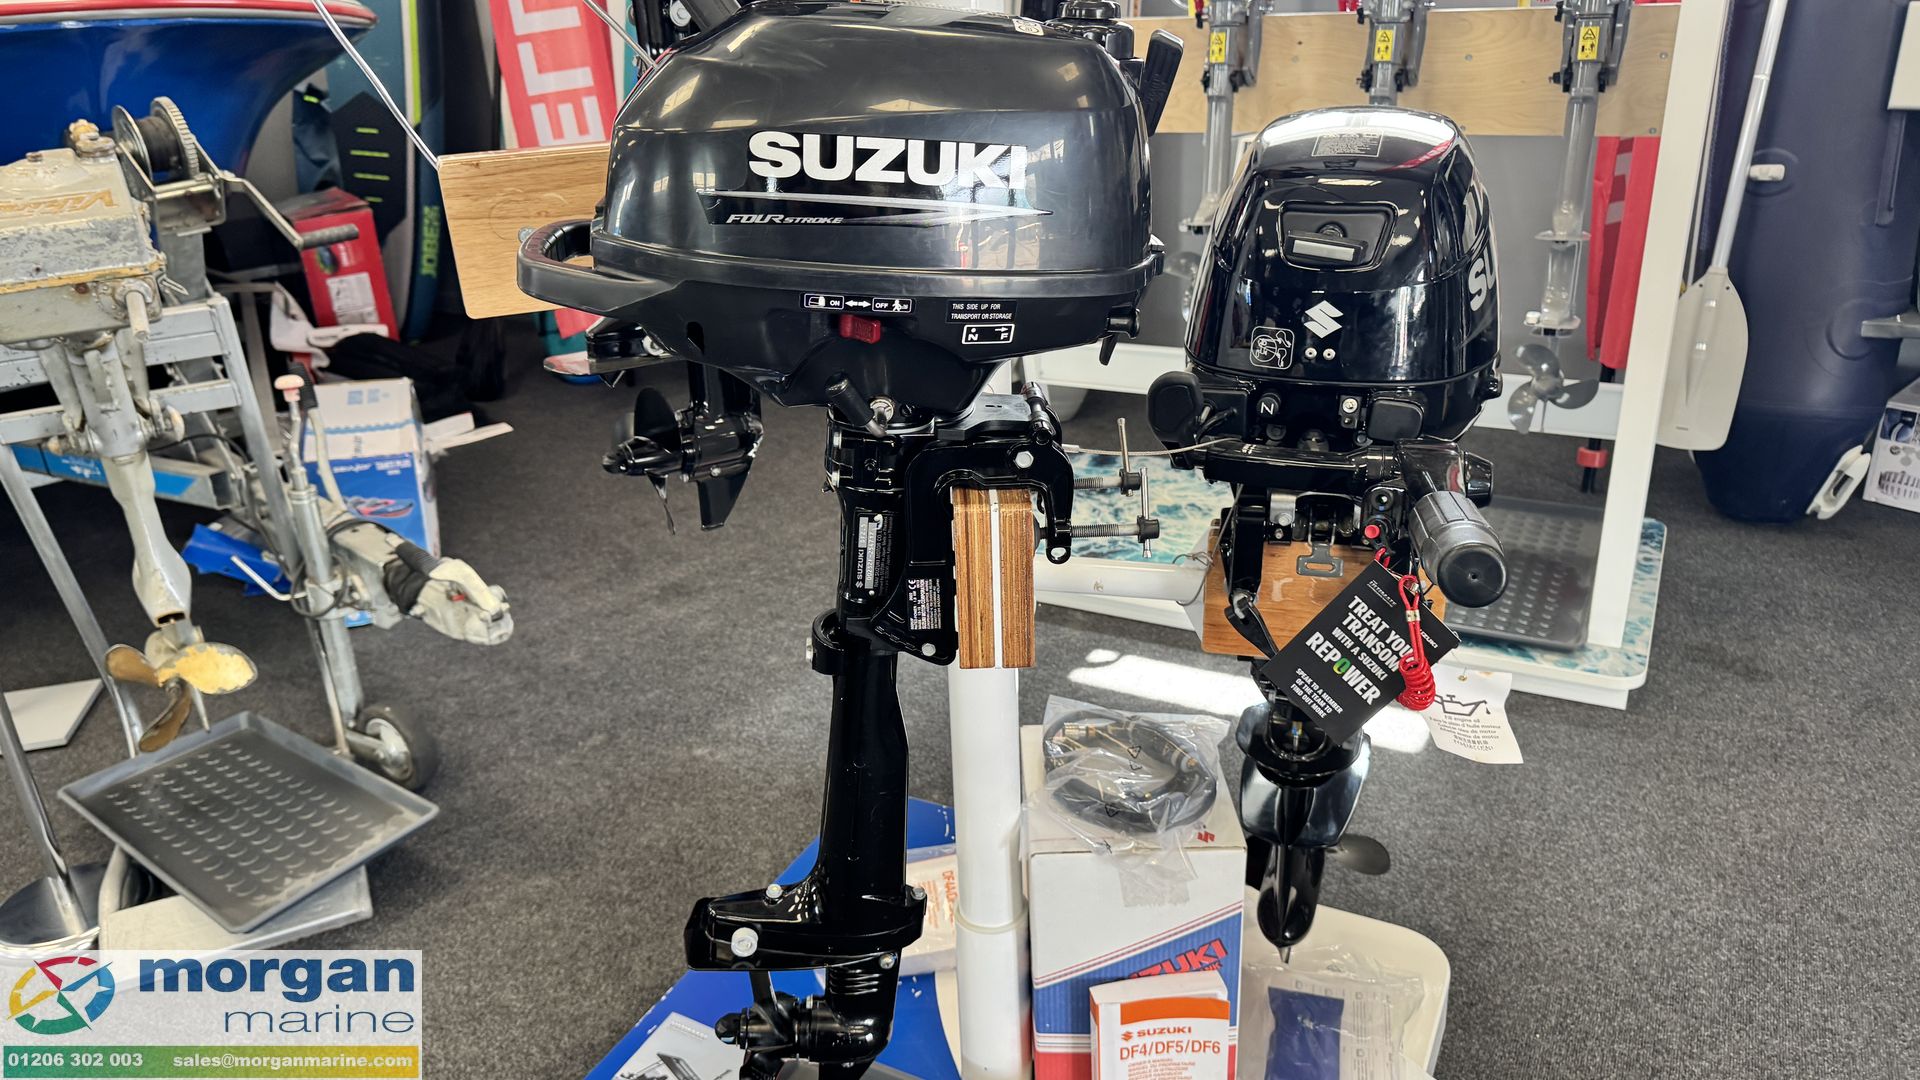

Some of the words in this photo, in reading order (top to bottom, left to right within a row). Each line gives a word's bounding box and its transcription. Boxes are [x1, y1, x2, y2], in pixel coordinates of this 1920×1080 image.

[749, 131, 1027, 190] SUZUKI
[726, 213, 784, 224] FOUR
[783, 216, 844, 224] STROKE
[967, 333, 979, 341] N
[1000, 333, 1009, 341] F
[1260, 402, 1275, 415] N
[856, 549, 864, 580] SUZUKI
[1347, 595, 1390, 637] TREAT
[1331, 626, 1355, 649] WITH
[1350, 644, 1361, 656] A
[1357, 651, 1388, 682] SUZUKI
[1340, 612, 1404, 673] TRANSOM
[1304, 630, 1383, 706] REPOWER
[1290, 683, 1304, 697] FIND
[1301, 694, 1313, 706] OUT
[1310, 703, 1327, 719] MORE
[1295, 667, 1313, 685] SPEAK
[1310, 682, 1319, 691] TO
[1320, 692, 1344, 714] MEMBER
[1295, 678, 1304, 687] OF
[1301, 684, 1314, 696] THE
[1311, 693, 1326, 708] TEAM
[1324, 705, 1333, 714] TO
[1130, 938, 1228, 979] ZUKI
[1137, 1026, 1192, 1037] SUZUKI
[1120, 1039, 1221, 1061] DF4/DF5/DF6
